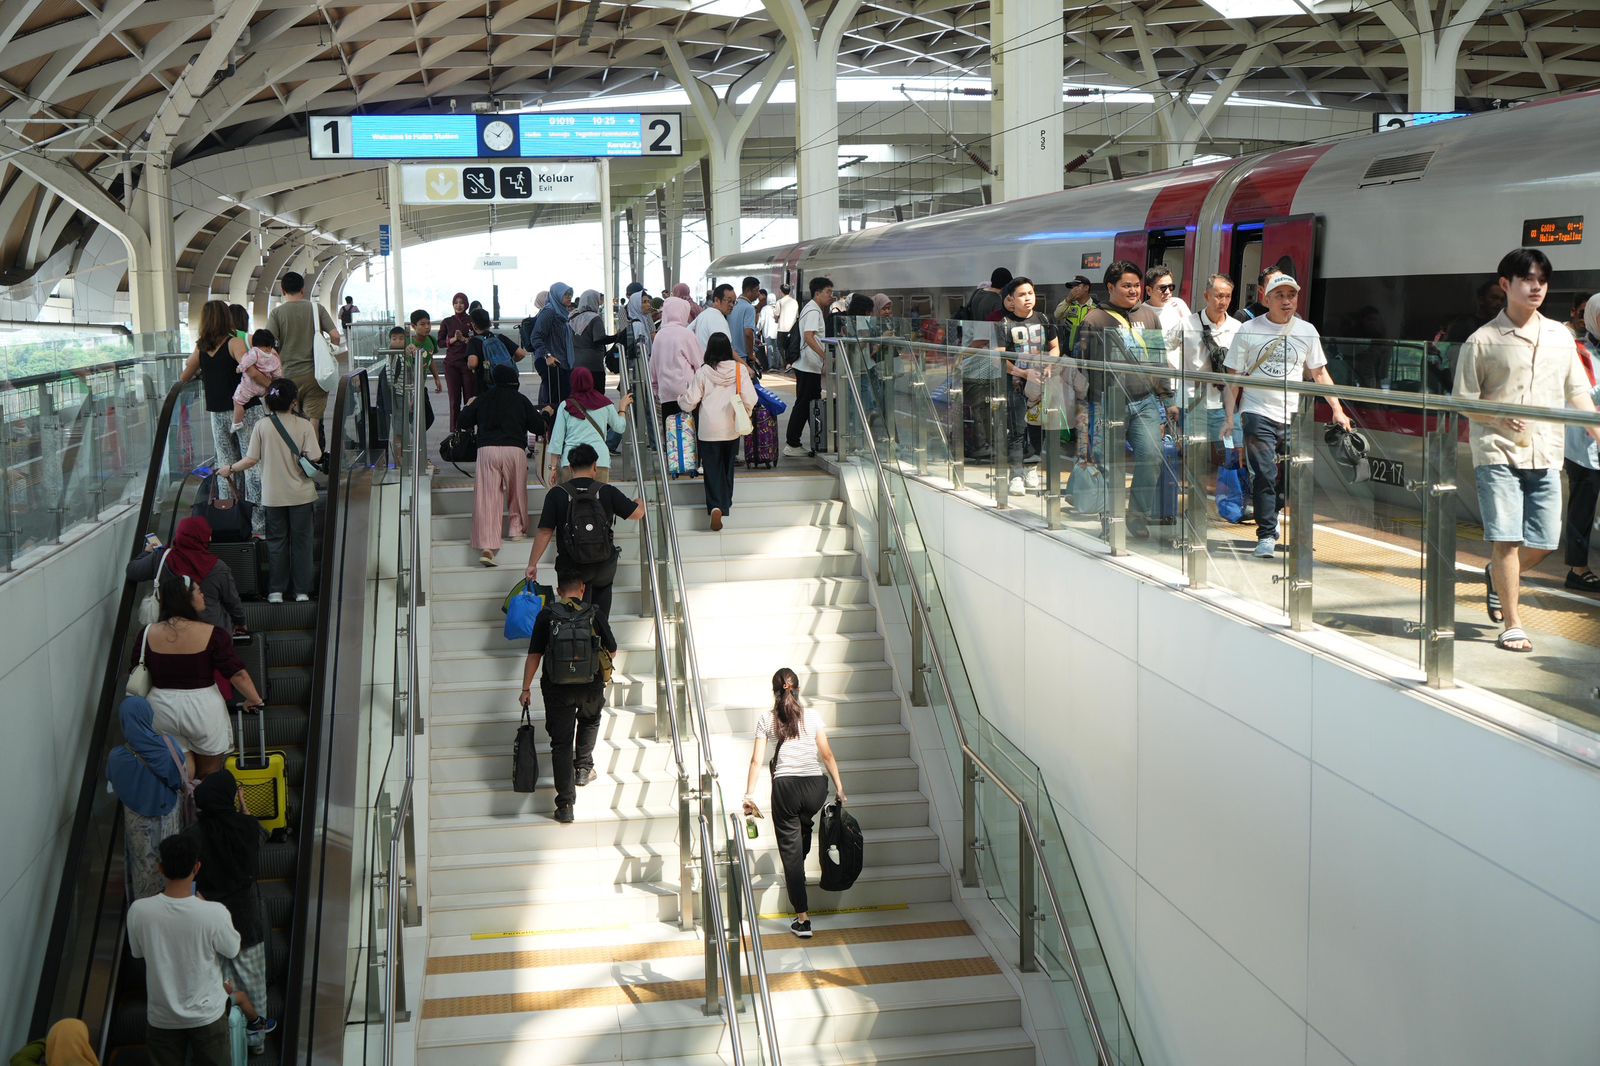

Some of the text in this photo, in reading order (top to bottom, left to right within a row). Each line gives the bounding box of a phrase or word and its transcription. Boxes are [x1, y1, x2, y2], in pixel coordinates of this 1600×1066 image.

[323, 120, 340, 154] 1
[648, 119, 672, 152] 2
[538, 174, 574, 183] Keluar
